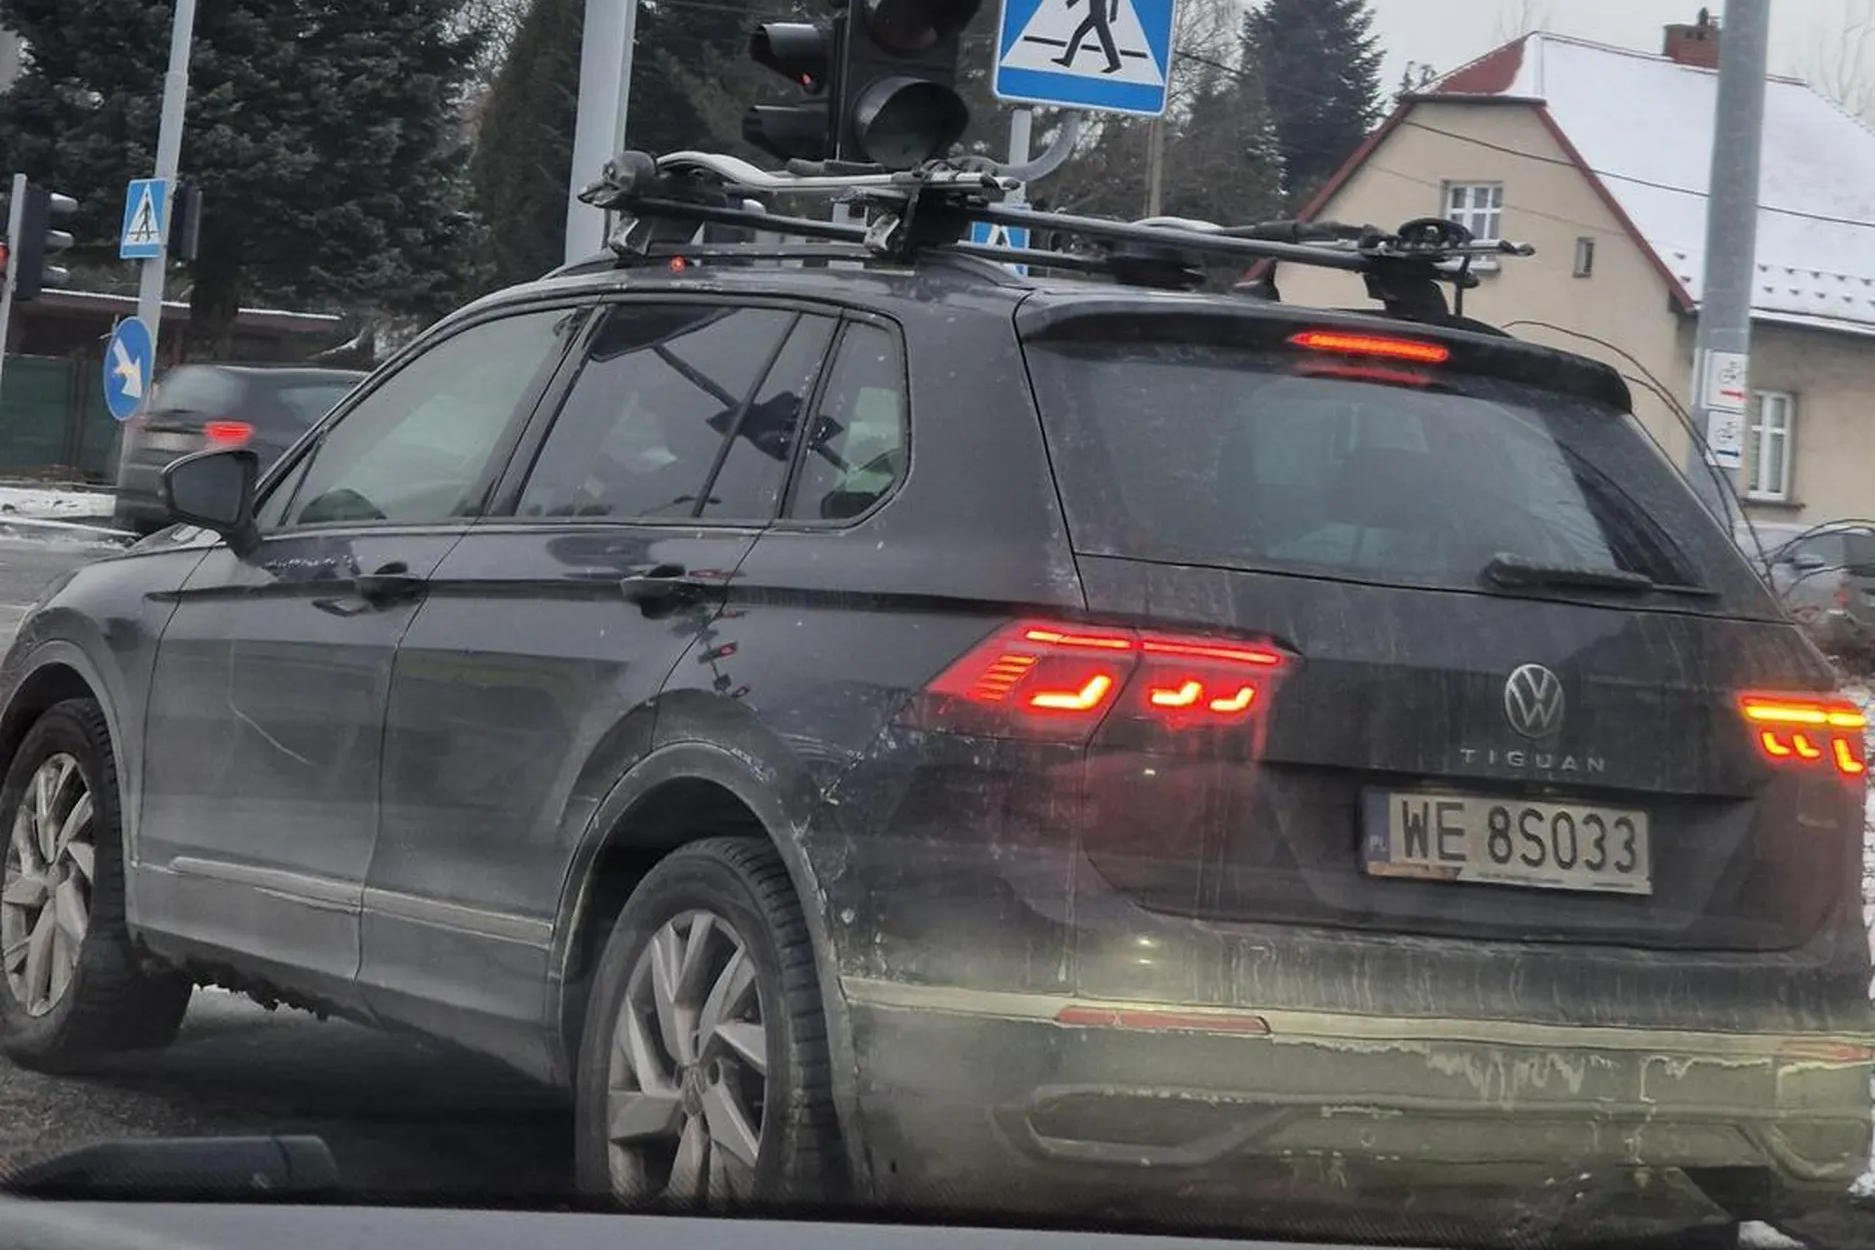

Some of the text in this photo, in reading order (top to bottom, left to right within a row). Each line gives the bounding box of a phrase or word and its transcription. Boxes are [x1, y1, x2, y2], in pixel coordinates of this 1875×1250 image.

[1460, 749, 1605, 772] TIGUAN
[1402, 800, 1637, 874] WE 8S033
